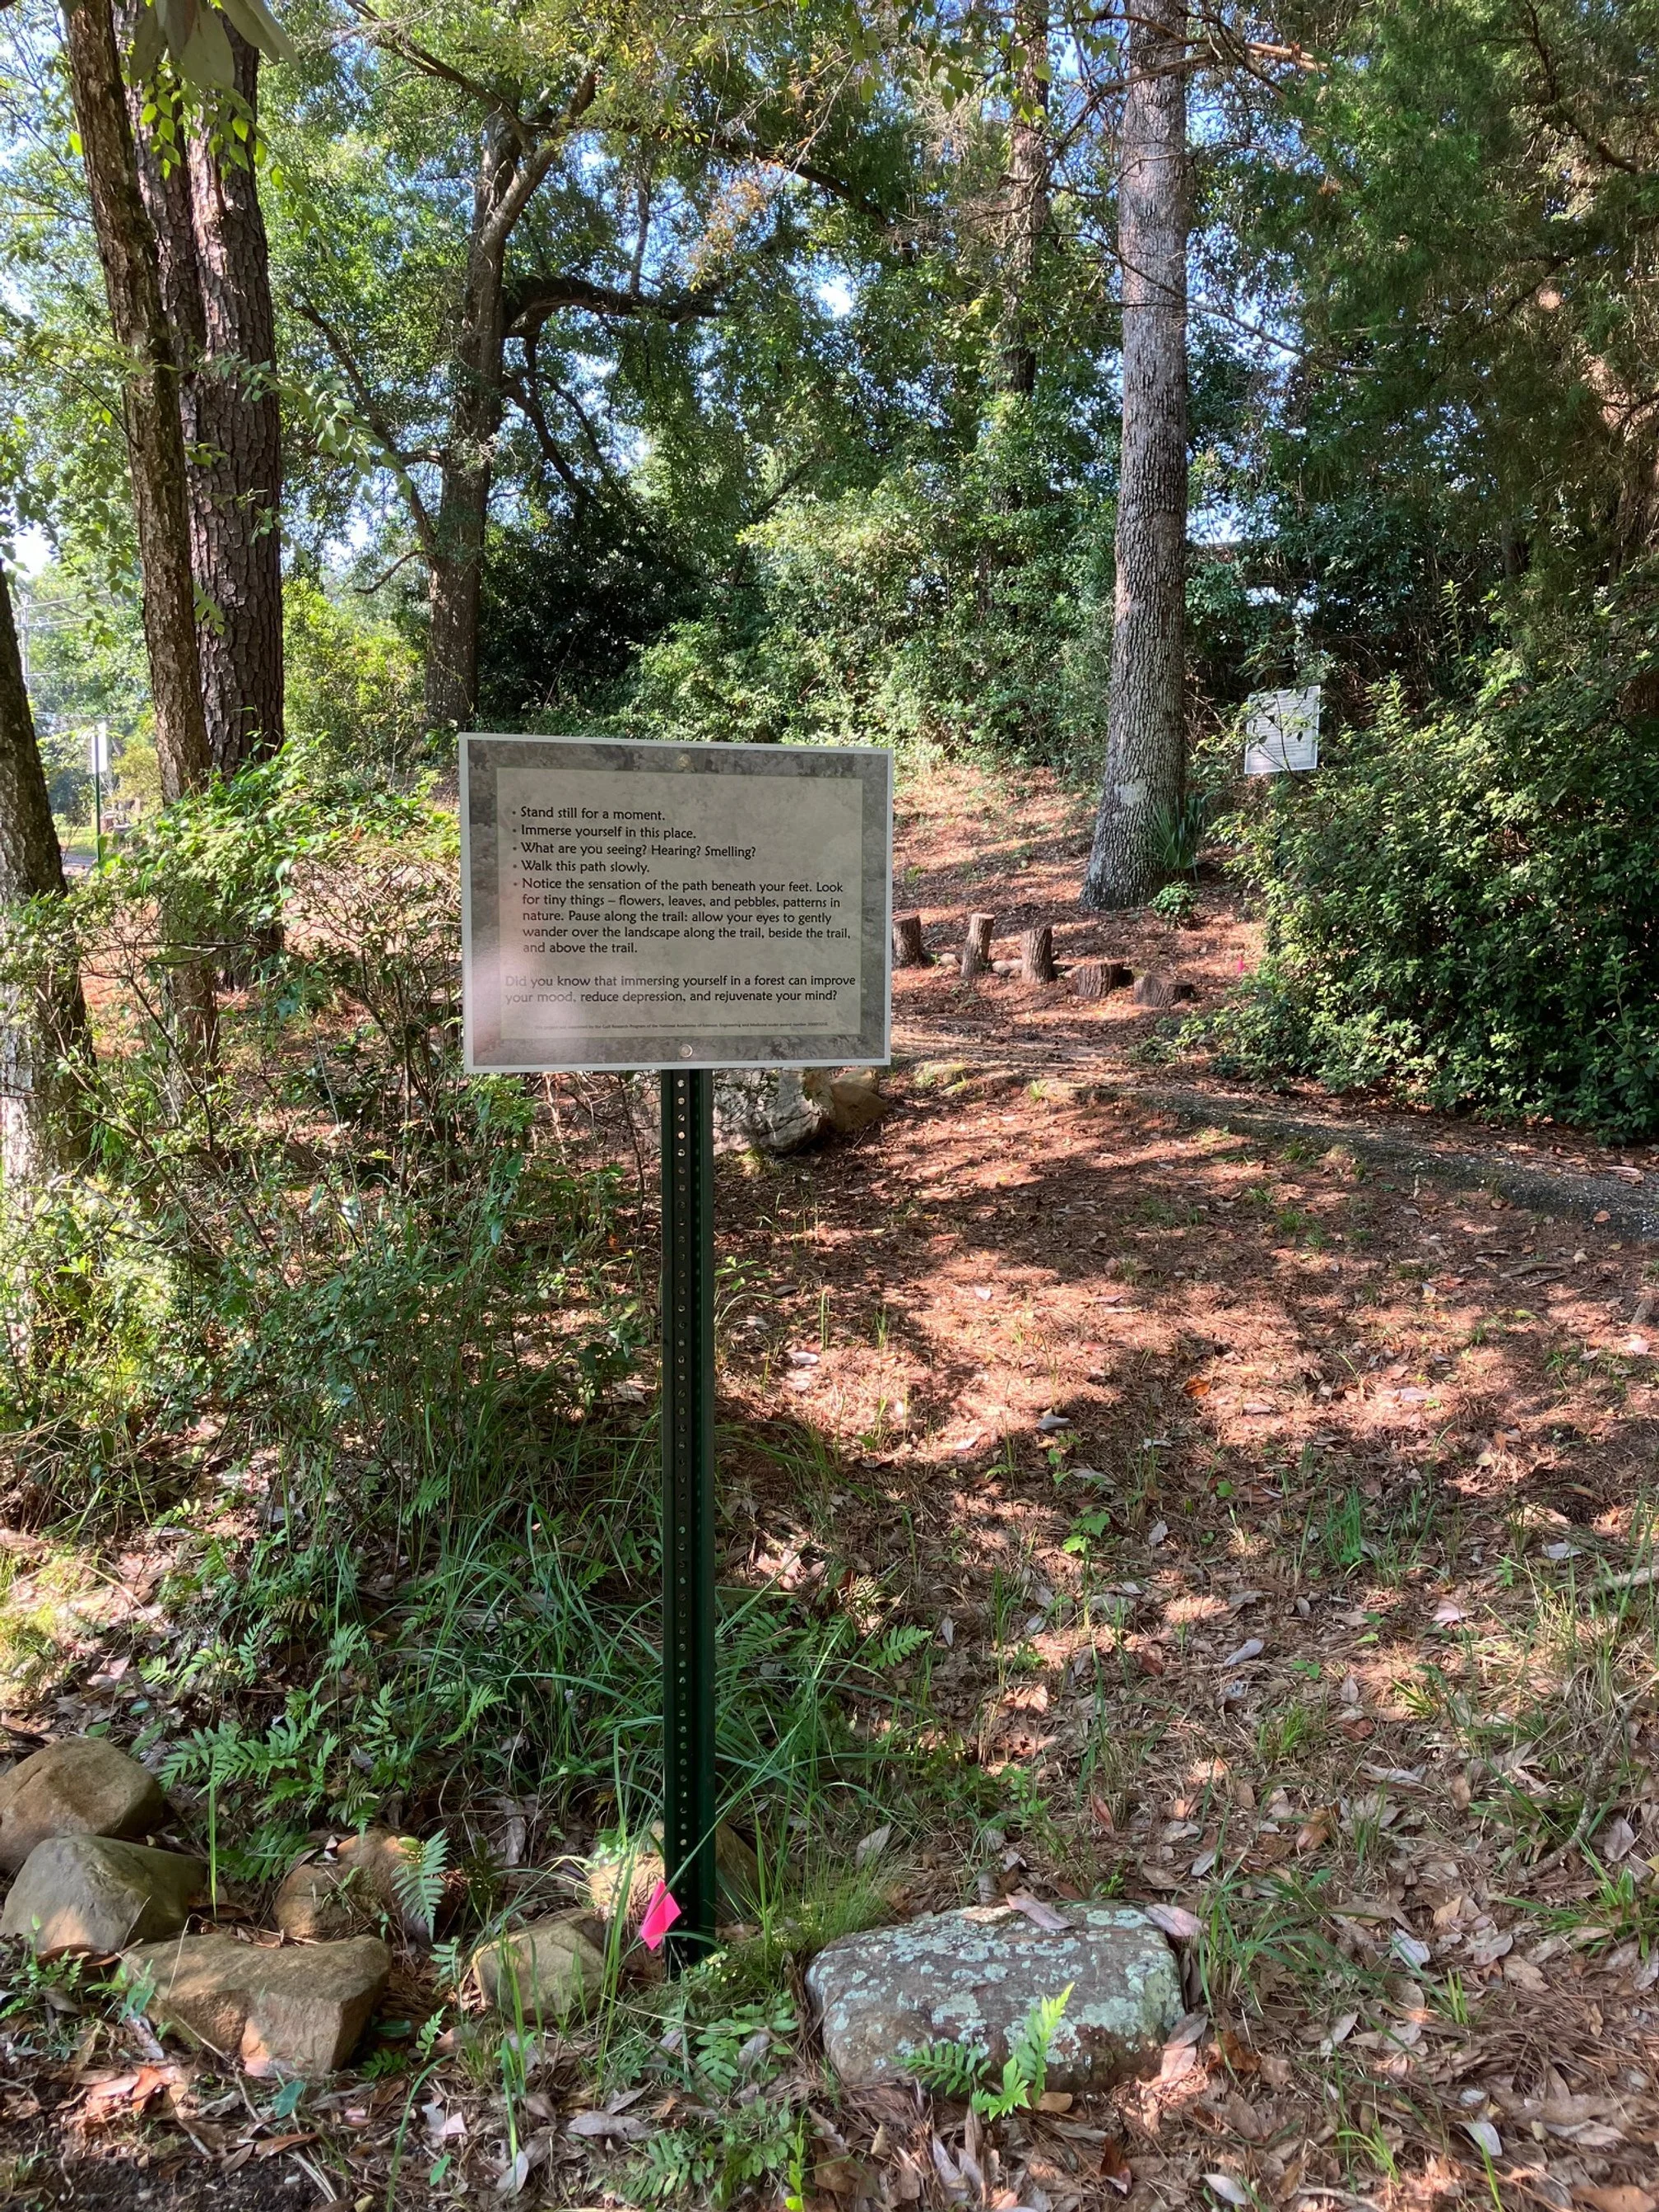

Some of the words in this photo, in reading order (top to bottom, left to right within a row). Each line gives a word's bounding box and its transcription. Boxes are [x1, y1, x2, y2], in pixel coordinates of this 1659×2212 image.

[521, 806, 554, 817] Stand
[558, 807, 577, 818] still
[581, 808, 598, 819] for
[602, 811, 609, 819] a
[613, 811, 665, 820] moment.
[522, 825, 571, 835] Immerse
[575, 825, 622, 839] yourself
[625, 827, 637, 837] in
[639, 827, 659, 838] this
[664, 827, 696, 840] place.
[521, 842, 554, 853] What
[558, 846, 577, 854] are
[580, 846, 602, 857] you
[607, 844, 647, 857] seeing?
[652, 845, 700, 858] Hearing?
[705, 846, 755, 860] Smelling?
[521, 859, 552, 871] Walk
[556, 861, 576, 871] this
[580, 861, 606, 874] path
[611, 861, 649, 875] slowly.
[523, 878, 561, 889] Notice
[565, 878, 584, 889] the
[588, 879, 640, 890] sensation
[644, 880, 658, 890] of
[661, 880, 679, 890] the
[683, 881, 708, 894] path
[712, 881, 755, 891] beneath
[760, 884, 785, 894] your
[788, 881, 811, 892] feet.
[816, 881, 843, 892] Look
[523, 894, 541, 904] for
[544, 895, 567, 908] tiny
[570, 895, 604, 908] things
[619, 895, 664, 907] flowers,
[668, 895, 705, 907] leaves,
[710, 896, 731, 907] and
[735, 896, 778, 909] pebbles,
[783, 898, 827, 909] patterns
[830, 898, 840, 908] in
[523, 912, 564, 921] nature.
[569, 910, 601, 921] Pause
[606, 910, 636, 924] along
[640, 910, 658, 921] the
[662, 912, 687, 922] trail:
[692, 912, 723, 922] allow
[728, 914, 753, 924] your
[756, 914, 779, 924] eyes
[783, 913, 795, 922] to
[798, 913, 831, 926] gently
[523, 927, 568, 936] wander
[602, 926, 620, 936] the
[625, 927, 680, 940] landscape
[684, 927, 715, 940] along
[718, 927, 736, 937] the
[740, 927, 764, 938] trail,
[769, 927, 802, 937] beside
[806, 927, 823, 937] the
[826, 927, 850, 938] trail,
[523, 942, 545, 952] and
[549, 942, 585, 953] above
[589, 942, 607, 953] the
[611, 942, 637, 953] trail.
[505, 976, 527, 986] Did
[530, 978, 553, 989] you
[557, 976, 590, 986] know
[594, 976, 617, 986] that
[621, 976, 679, 988] immersing
[683, 975, 727, 988] yourself
[731, 976, 741, 986] in
[744, 978, 750, 986] a
[755, 975, 785, 986] forest
[788, 978, 807, 986] can
[811, 975, 855, 988] improve
[505, 992, 533, 1004] your
[537, 991, 576, 1001] mood,
[581, 992, 619, 1001] reduce
[622, 991, 685, 1003] depression,
[690, 990, 711, 1001] and
[714, 991, 772, 1003] rejuvenate
[776, 992, 802, 1002] your
[805, 989, 838, 1000] mind?
